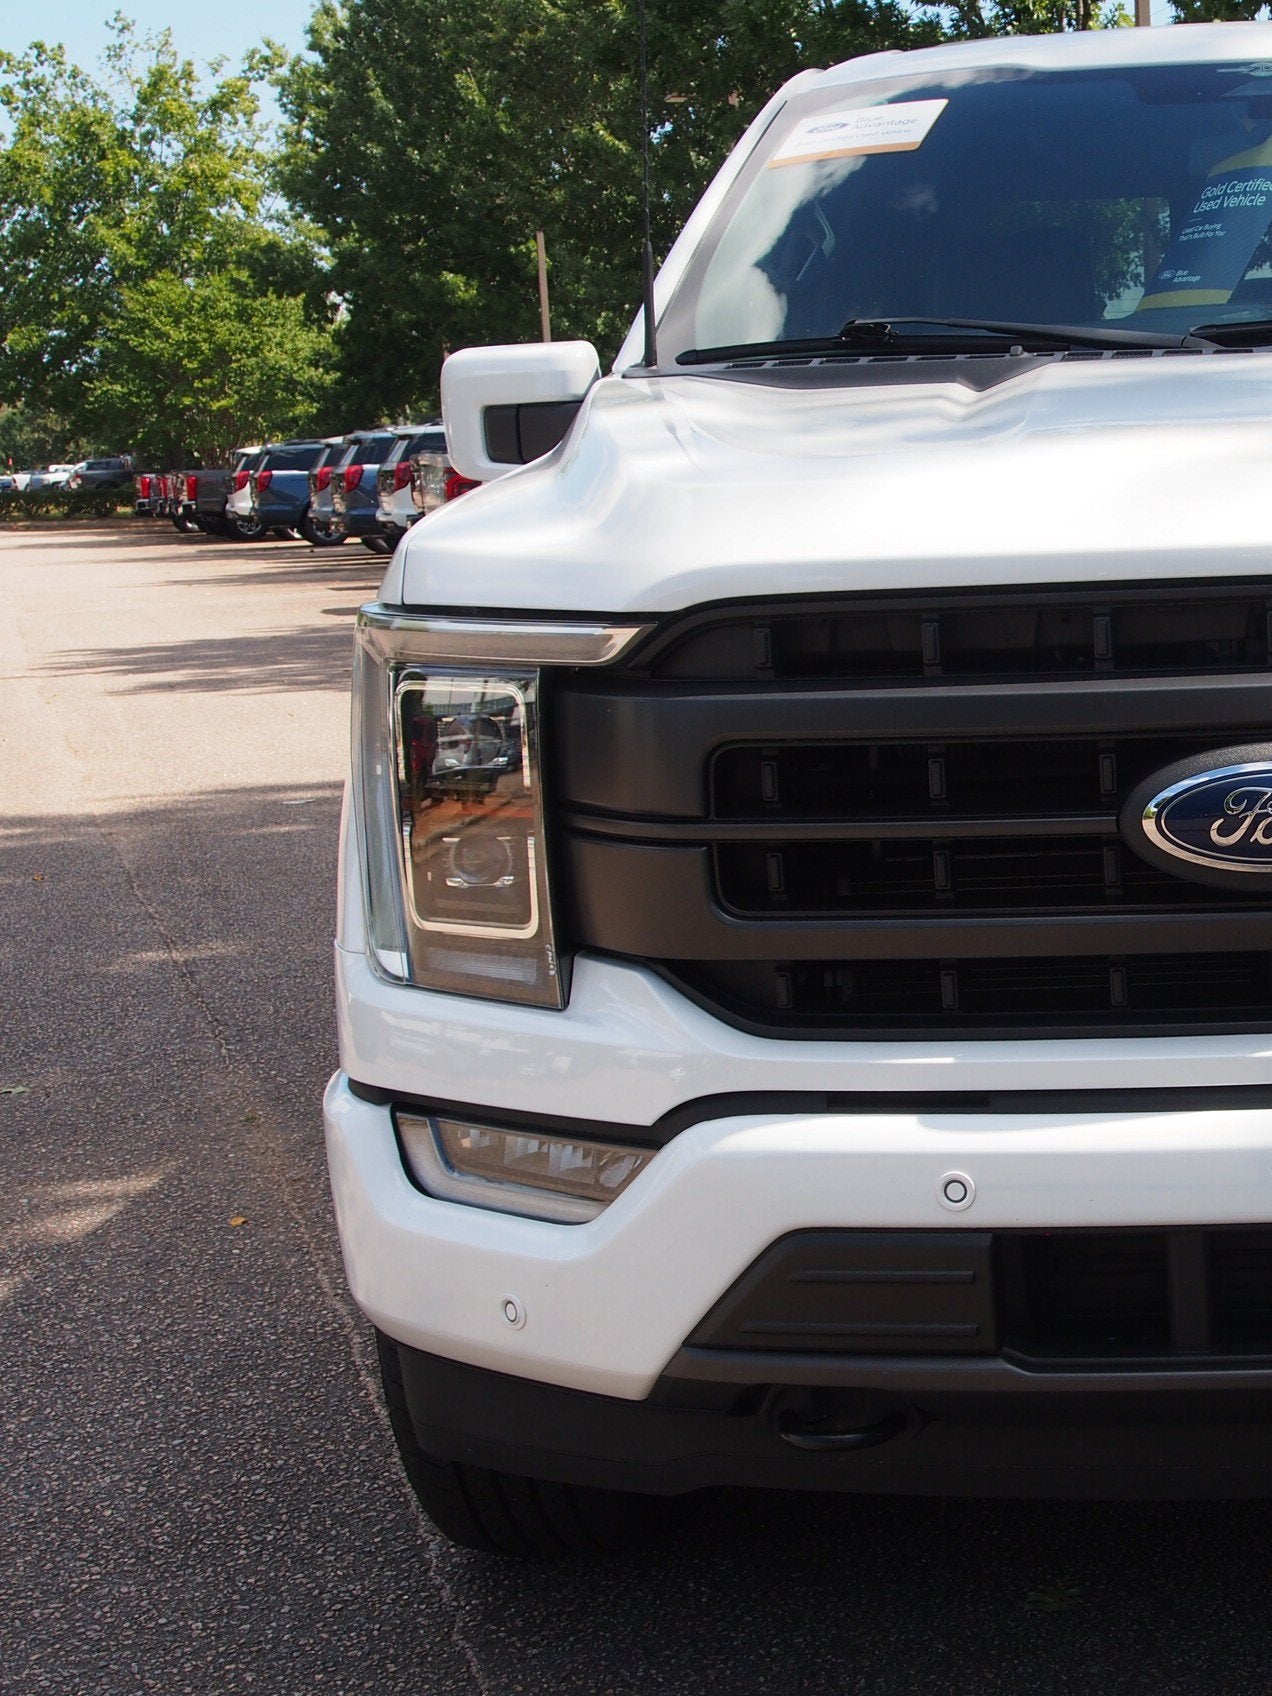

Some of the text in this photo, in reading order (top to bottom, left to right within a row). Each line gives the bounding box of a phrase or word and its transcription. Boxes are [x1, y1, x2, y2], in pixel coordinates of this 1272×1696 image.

[1201, 182, 1228, 199] Gold
[1193, 193, 1266, 213] Used Vehicle
